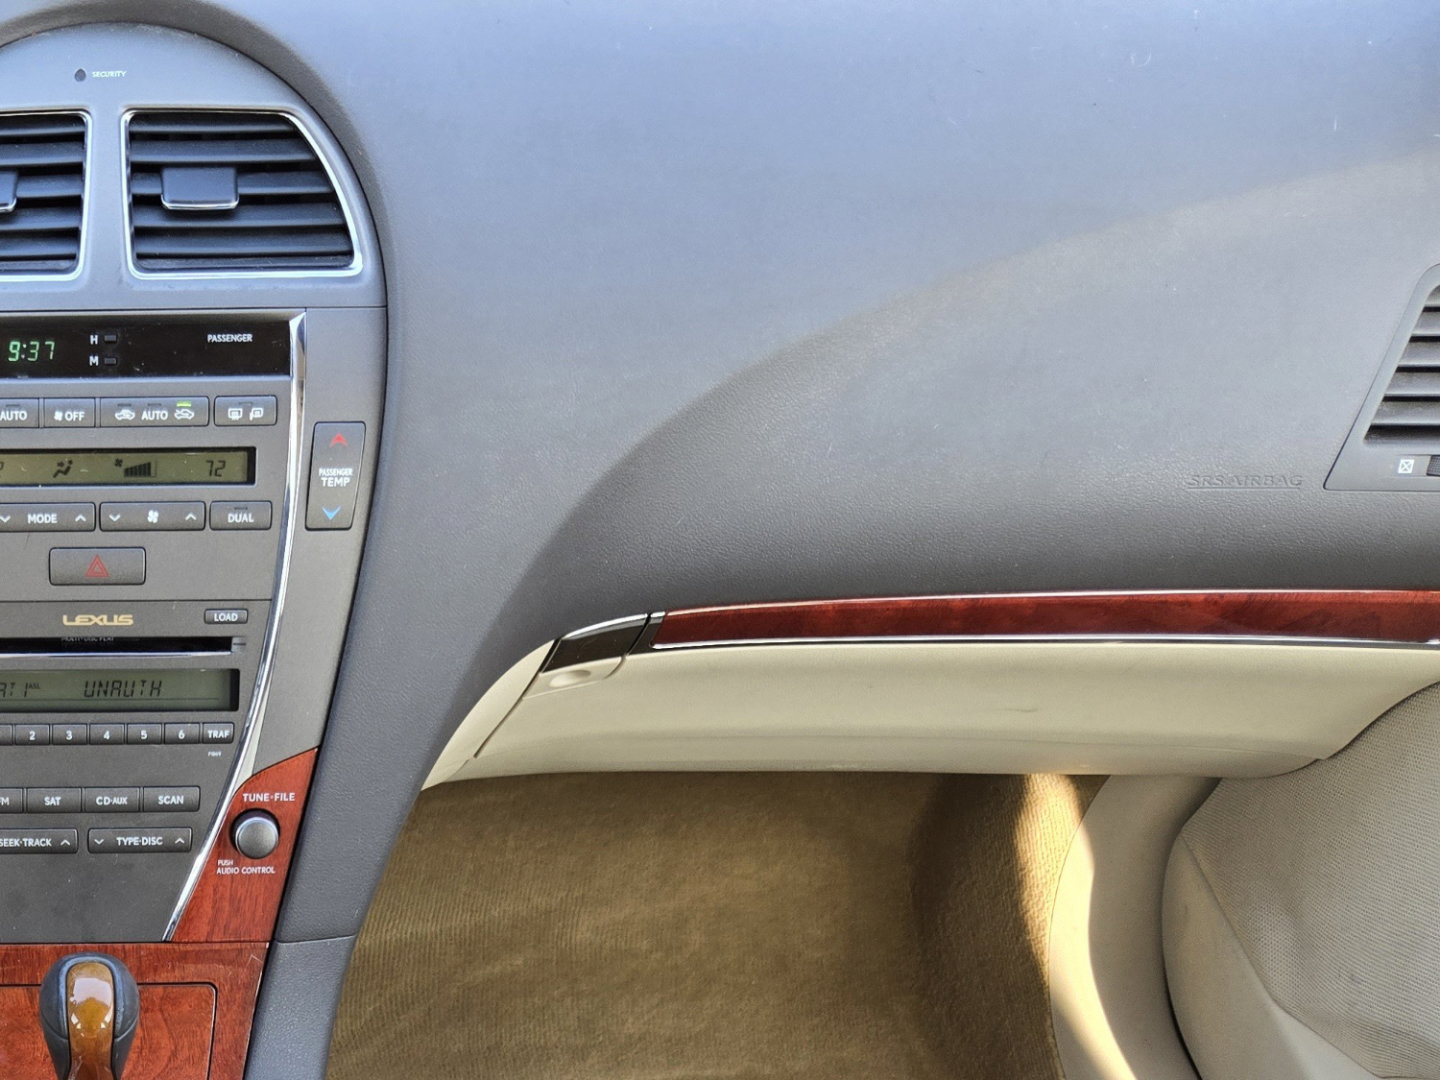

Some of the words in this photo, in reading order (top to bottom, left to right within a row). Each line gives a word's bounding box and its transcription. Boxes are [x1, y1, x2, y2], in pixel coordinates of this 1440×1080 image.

[92, 70, 127, 78] SECURITY
[90, 334, 98, 345] H
[207, 333, 253, 343] PASSENGER
[8, 341, 55, 362] 9:37
[89, 355, 99, 366] M
[0, 410, 28, 421] AUTO
[64, 410, 85, 421] OFF
[141, 410, 169, 421] AUTO
[205, 460, 226, 477] 72
[318, 467, 354, 477] PASSENGER
[321, 477, 350, 488] TEMP
[27, 513, 58, 524] MODE
[227, 513, 254, 523] DUAL
[62, 614, 134, 626] LEXUS
[214, 613, 239, 622] LOAD
[83, 680, 162, 698] UNAUTH
[29, 731, 36, 740] 2
[66, 730, 73, 740] 3
[103, 730, 110, 739] 4
[140, 730, 148, 739] 5
[178, 730, 186, 739] 6
[207, 730, 230, 739] TRAF
[44, 797, 62, 806] SAT
[158, 795, 185, 805] SCAN
[217, 866, 240, 875] AUDIO
[241, 866, 276, 875] CONTROL
